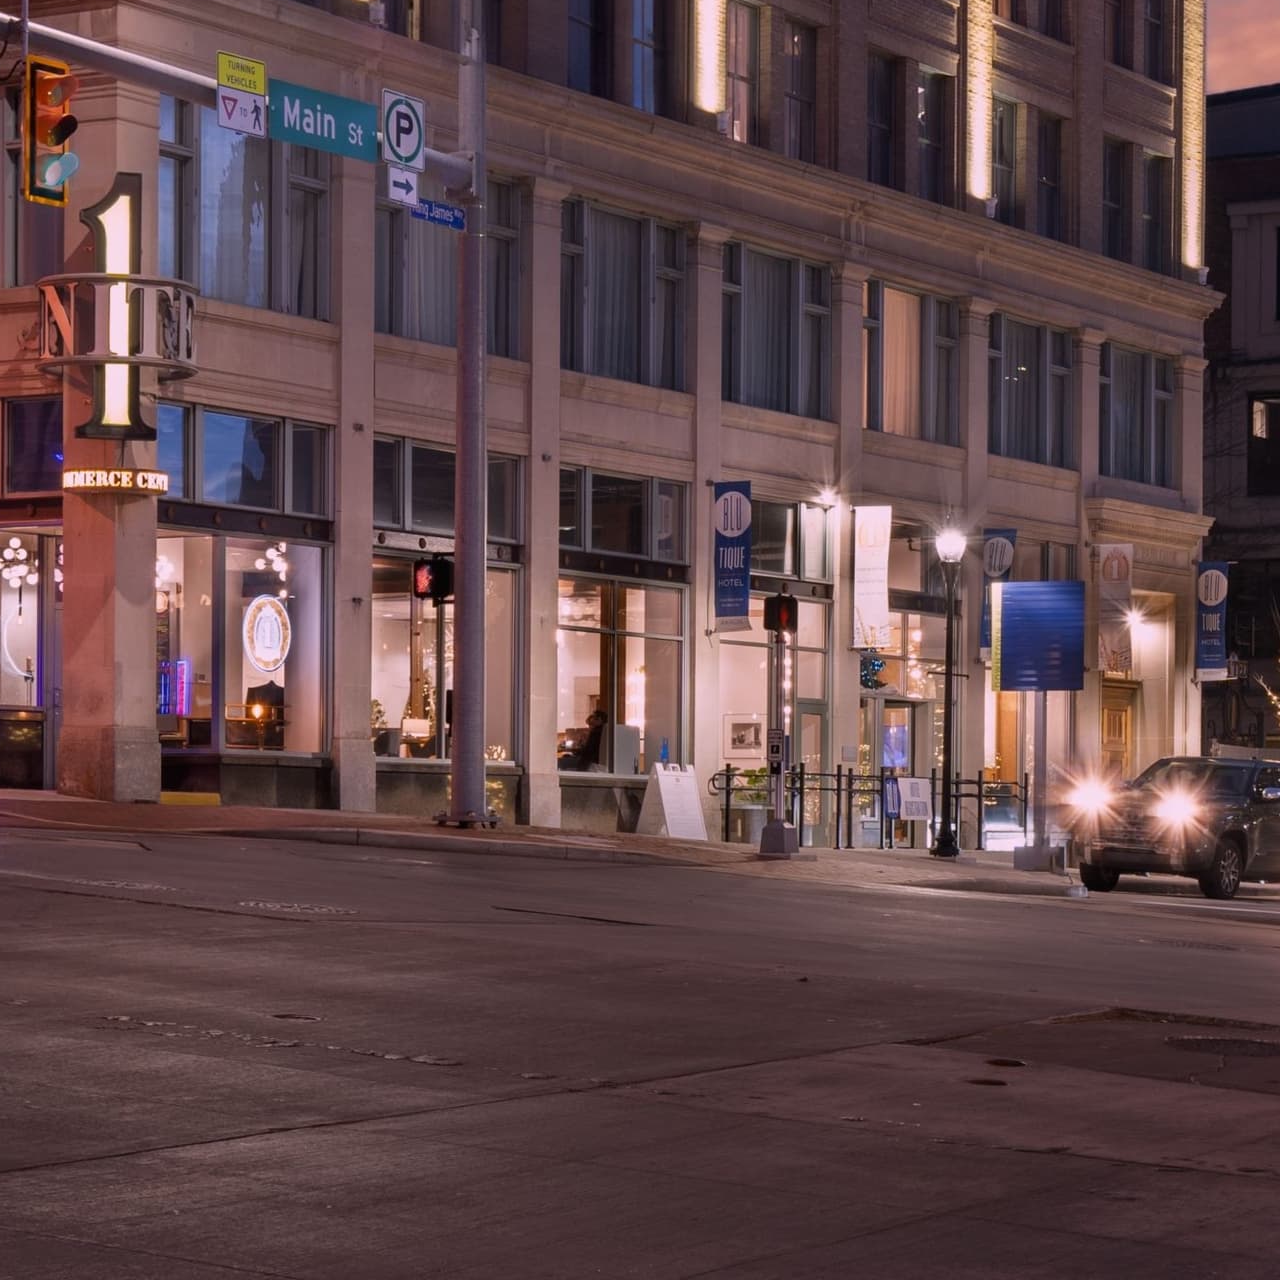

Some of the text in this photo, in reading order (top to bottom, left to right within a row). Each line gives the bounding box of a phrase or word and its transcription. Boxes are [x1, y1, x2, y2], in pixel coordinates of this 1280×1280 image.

[227, 60, 256, 75] TURNING
[225, 73, 257, 90] VEHICLES
[283, 95, 364, 146] Main St
[395, 109, 414, 149] P
[429, 202, 454, 222] James
[723, 495, 742, 531] BLU
[719, 546, 745, 570] TIQUE
[719, 578, 745, 587] HOTEL
